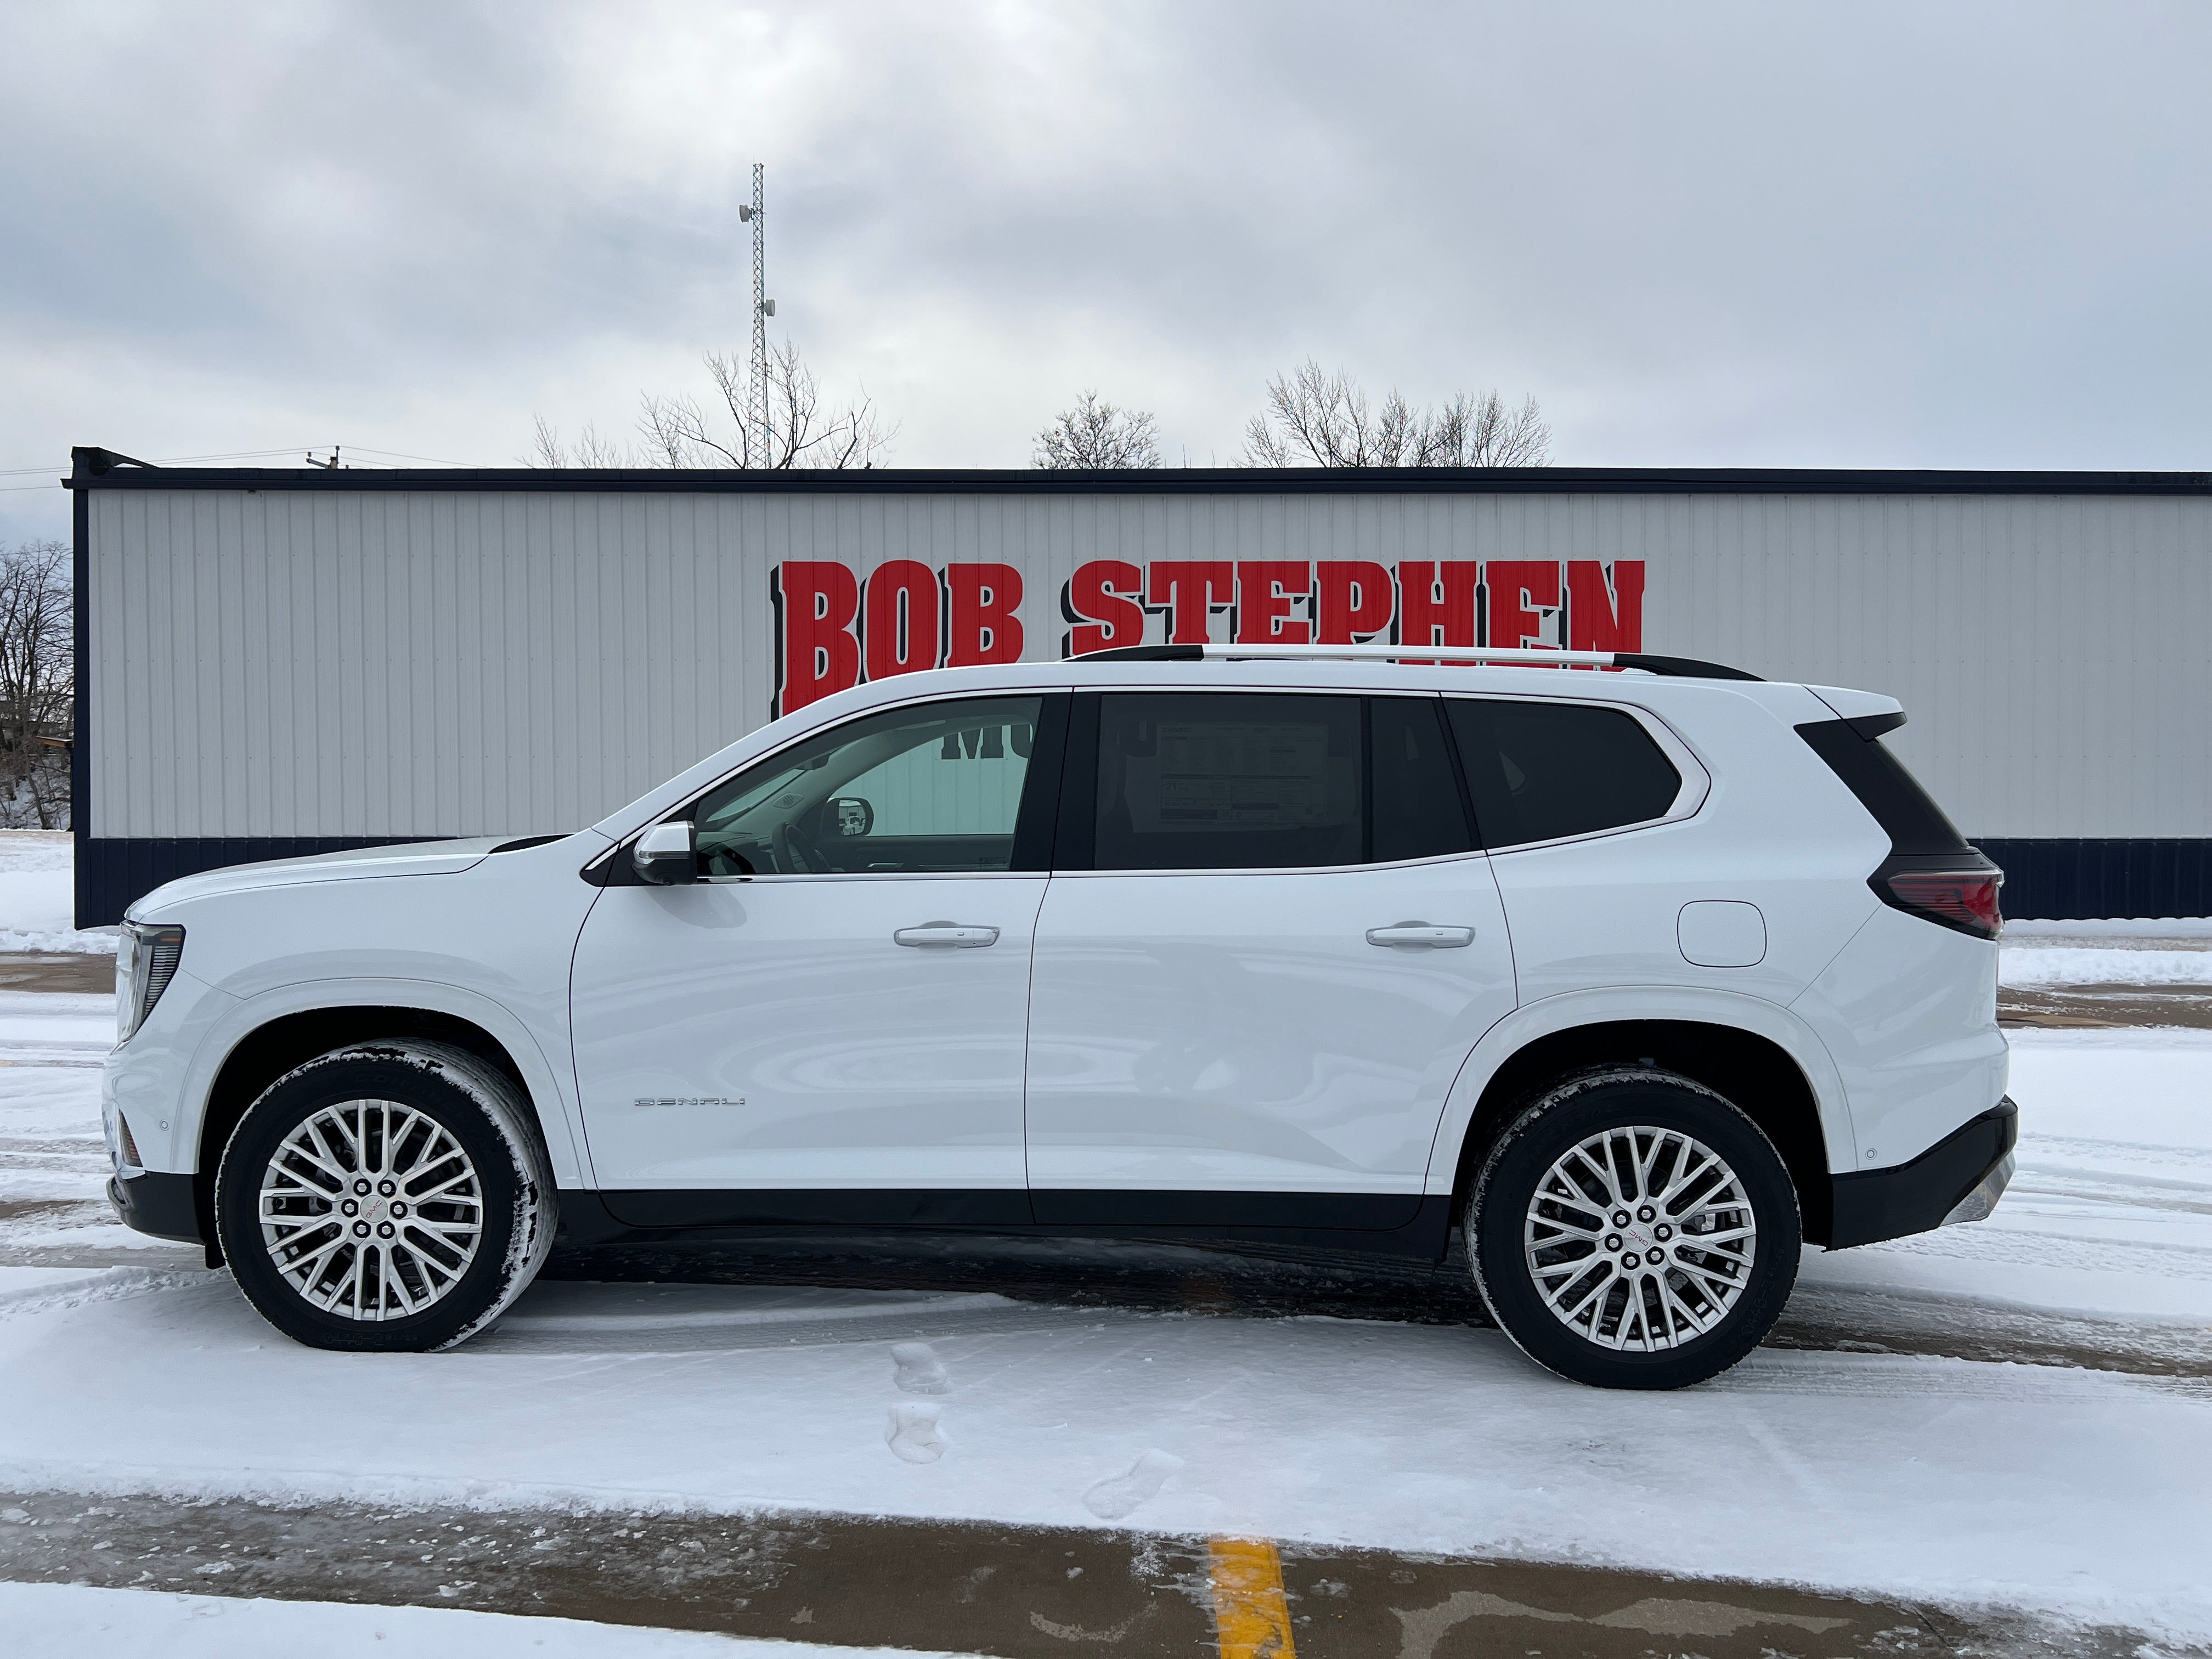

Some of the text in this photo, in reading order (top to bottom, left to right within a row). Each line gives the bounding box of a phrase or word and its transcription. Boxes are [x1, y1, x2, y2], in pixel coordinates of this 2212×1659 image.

[771, 560, 1645, 722] BOB STEPHEN
[634, 1098, 745, 1106] DENALI
[365, 1200, 383, 1218] GMC
[1628, 1229, 1649, 1246] GMC
